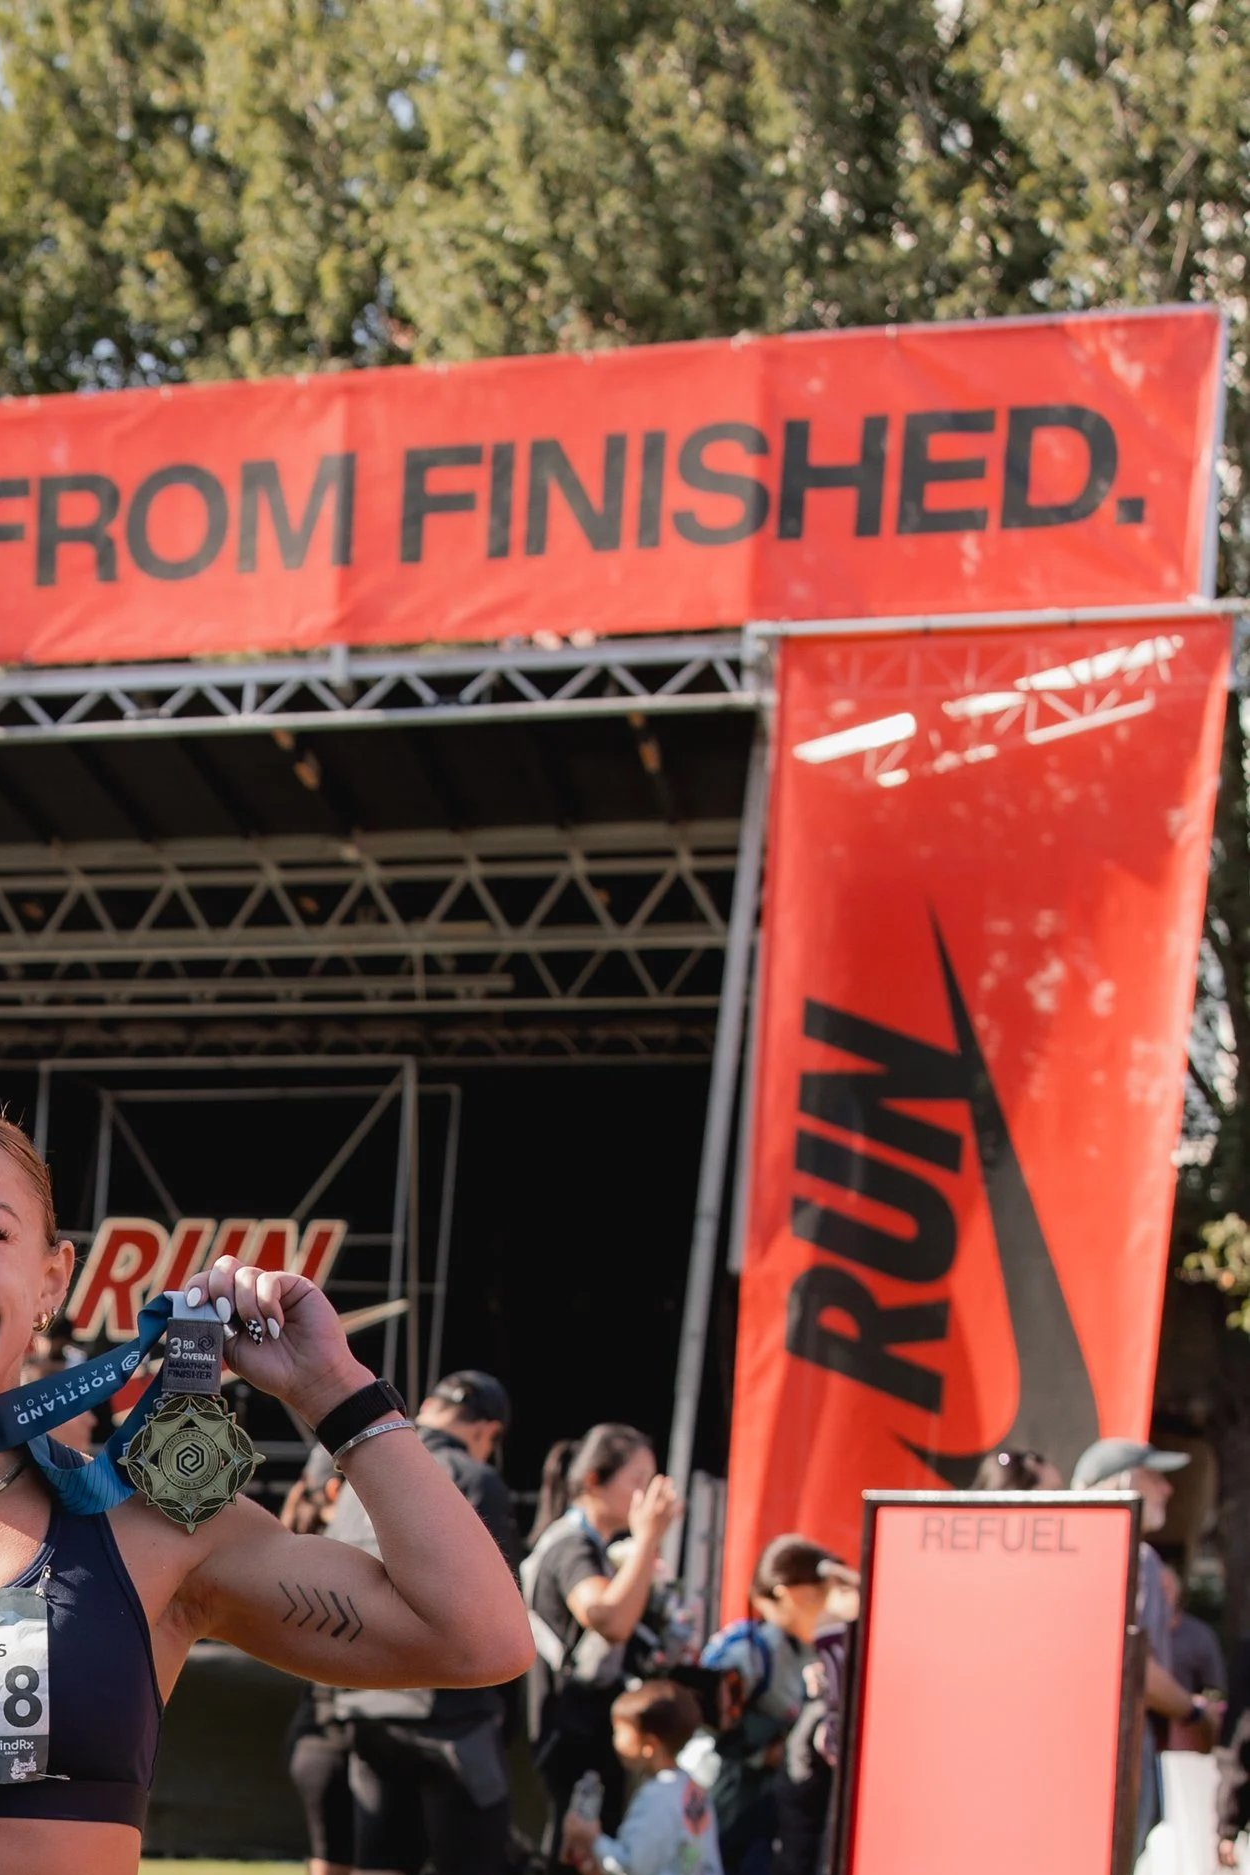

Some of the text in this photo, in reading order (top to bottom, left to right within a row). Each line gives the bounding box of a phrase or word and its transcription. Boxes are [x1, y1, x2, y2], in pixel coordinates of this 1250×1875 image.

[399, 404, 1146, 564] FINISHED.
[785, 997, 966, 1416] RUN
[167, 1369, 212, 1379] FINISHER
[168, 1360, 212, 1370] MARATHON
[182, 1353, 216, 1361] OVERALL
[13, 1363, 113, 1412] MARATHON
[17, 1371, 117, 1425] PORTLAND
[920, 1516, 1078, 1552] REFUEL
